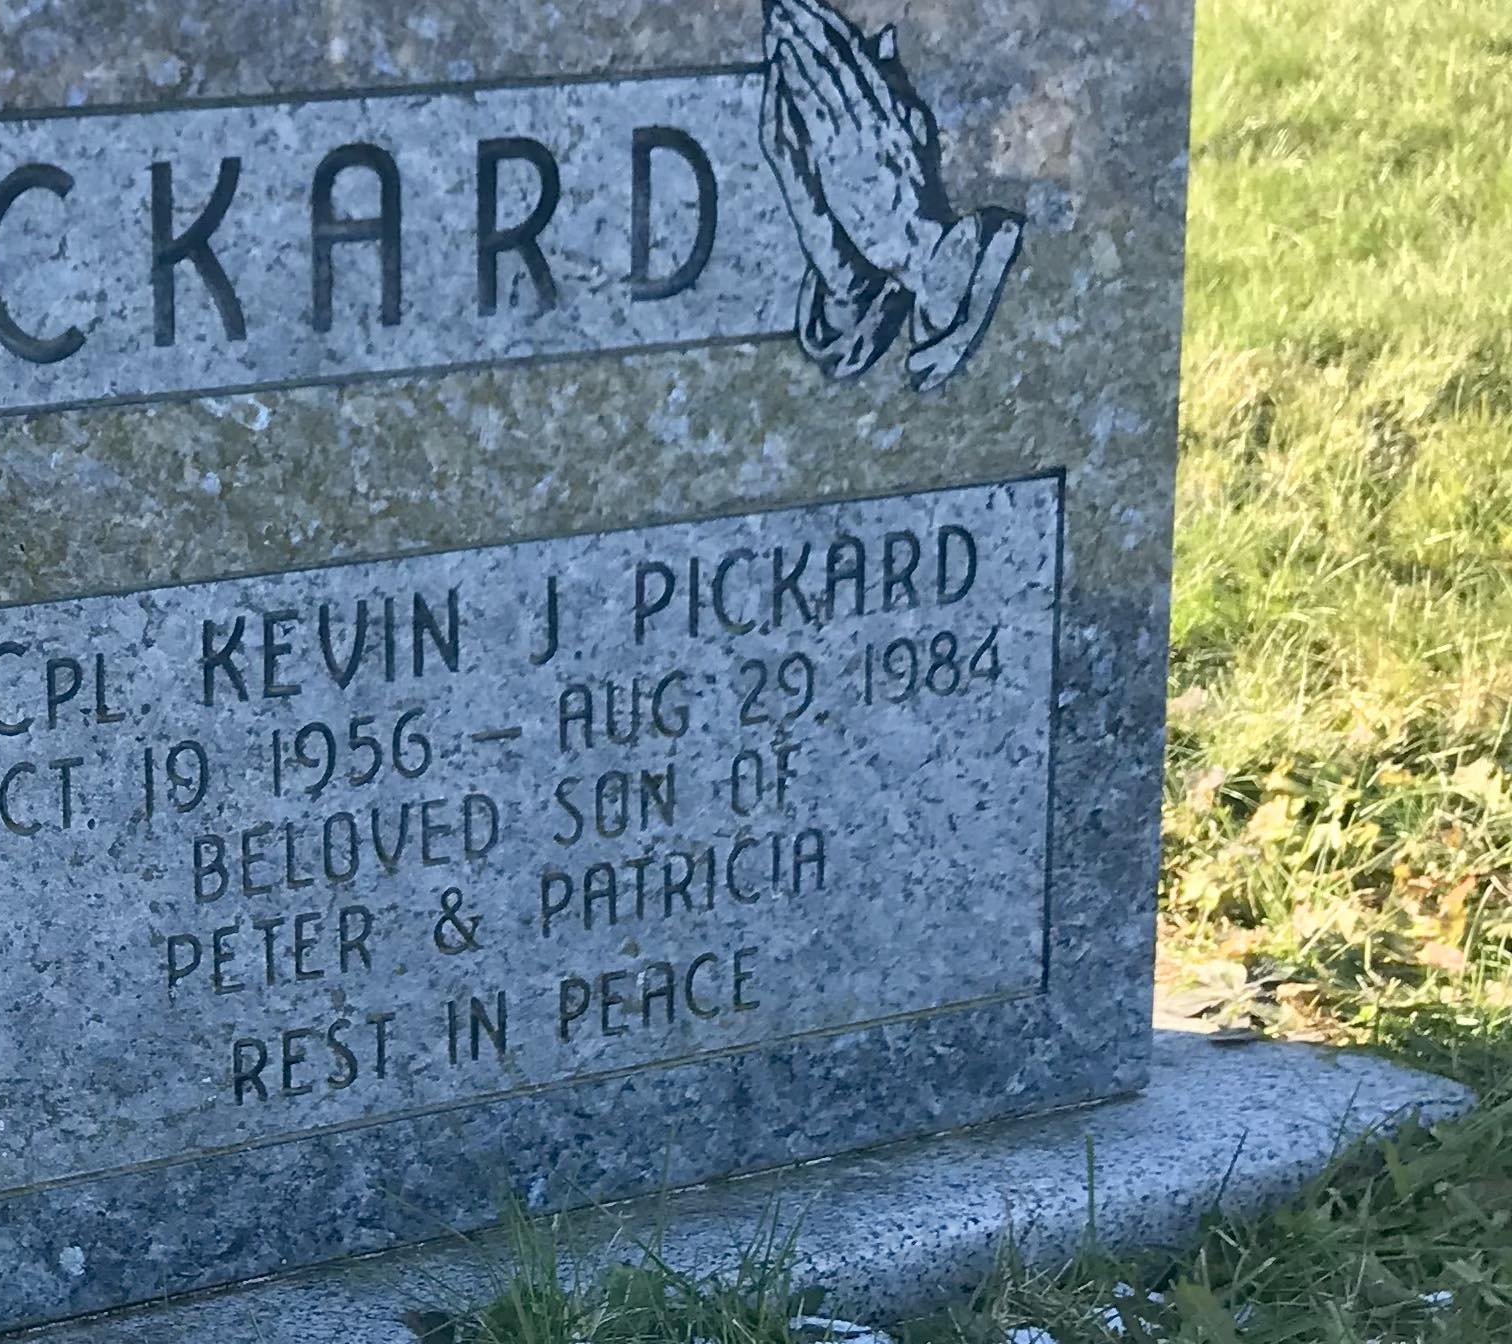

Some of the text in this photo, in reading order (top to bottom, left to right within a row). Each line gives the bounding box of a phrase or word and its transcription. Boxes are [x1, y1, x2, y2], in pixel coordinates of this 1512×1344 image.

[201, 584, 460, 707] KEVIN
[634, 523, 978, 646] PICKARD
[271, 706, 432, 802] 1956
[863, 623, 1003, 707] 1984
[193, 744, 800, 904] BELOVED SON OF
[167, 828, 826, 996] PETER & PATRICIA
[232, 946, 760, 1106] REST IN PEACE
